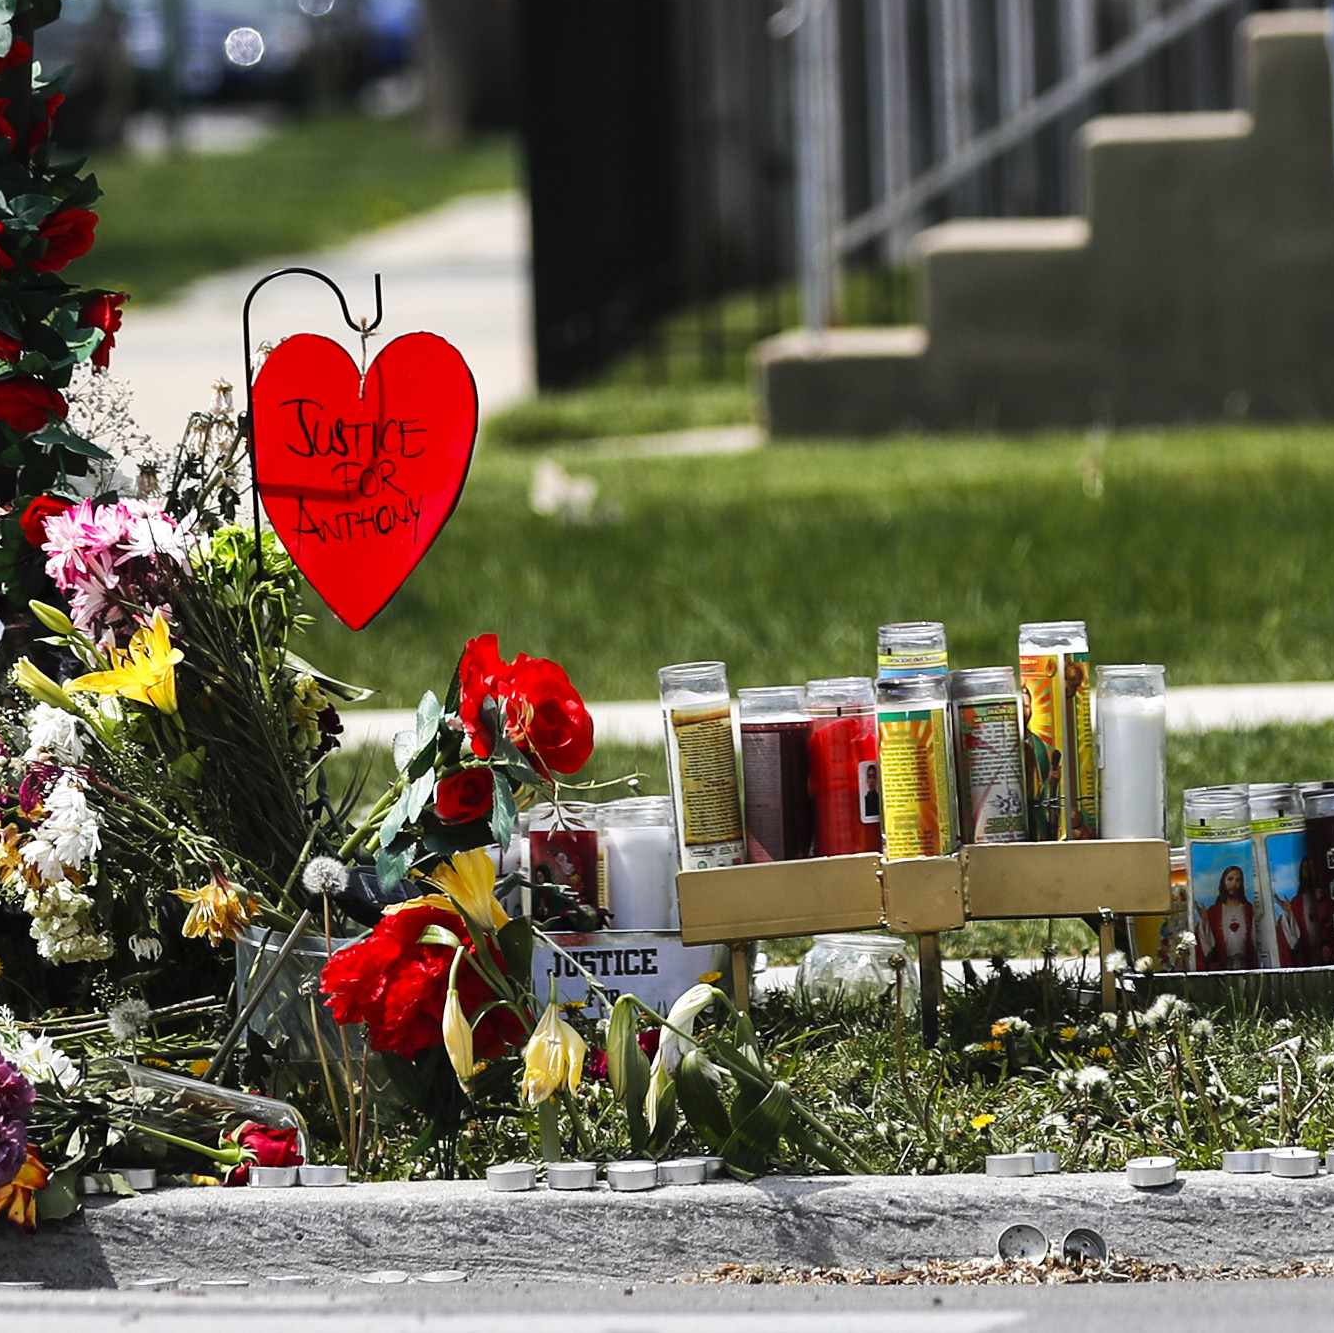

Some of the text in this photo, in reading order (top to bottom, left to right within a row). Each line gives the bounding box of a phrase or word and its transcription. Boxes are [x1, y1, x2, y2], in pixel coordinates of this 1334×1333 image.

[279, 398, 427, 458] JUSTICE
[331, 460, 408, 498] FOR
[290, 494, 423, 559] ANTHONY
[547, 948, 659, 979] JUSTICE
